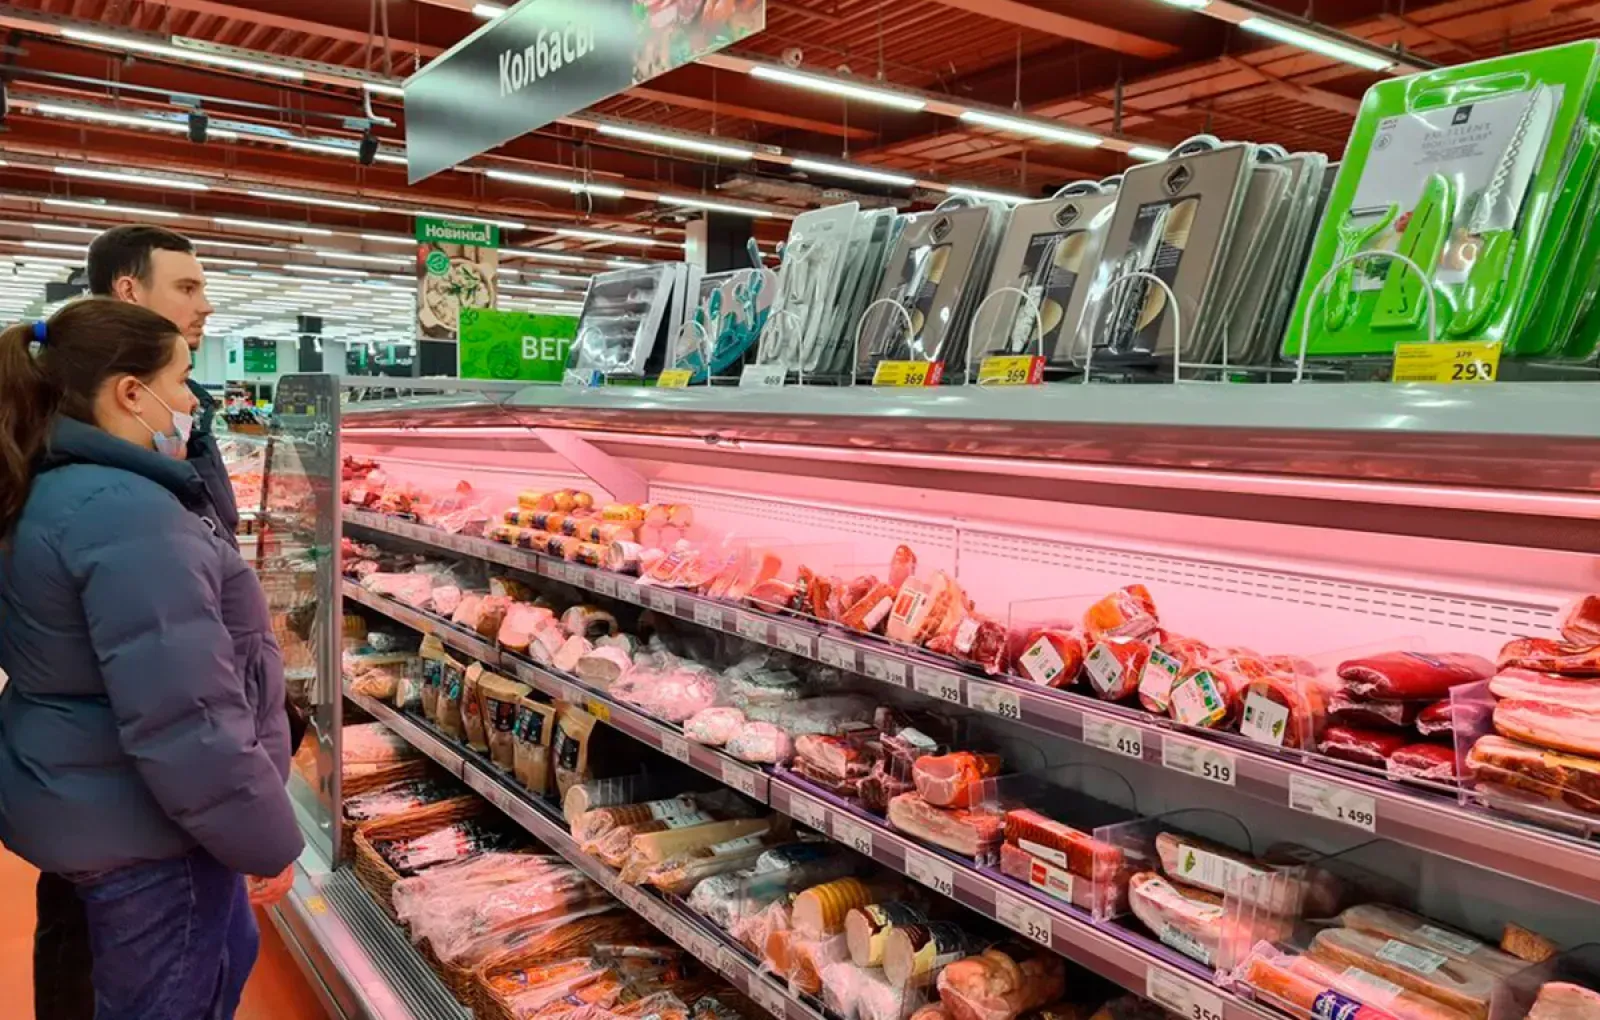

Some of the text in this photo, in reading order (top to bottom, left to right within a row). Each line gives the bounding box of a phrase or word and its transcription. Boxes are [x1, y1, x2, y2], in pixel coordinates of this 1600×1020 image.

[499, 25, 595, 97] Колбасы
[425, 223, 491, 245] Новинка!
[903, 373, 924, 385] 369
[1004, 370, 1026, 383] 369
[941, 686, 958, 701] 929
[998, 703, 1017, 719] 859
[1117, 738, 1141, 756] 419
[1202, 762, 1230, 782] 519
[1337, 806, 1373, 825] 1 499
[854, 837, 870, 854] 629
[933, 875, 952, 896] 749
[1027, 921, 1049, 943] 329
